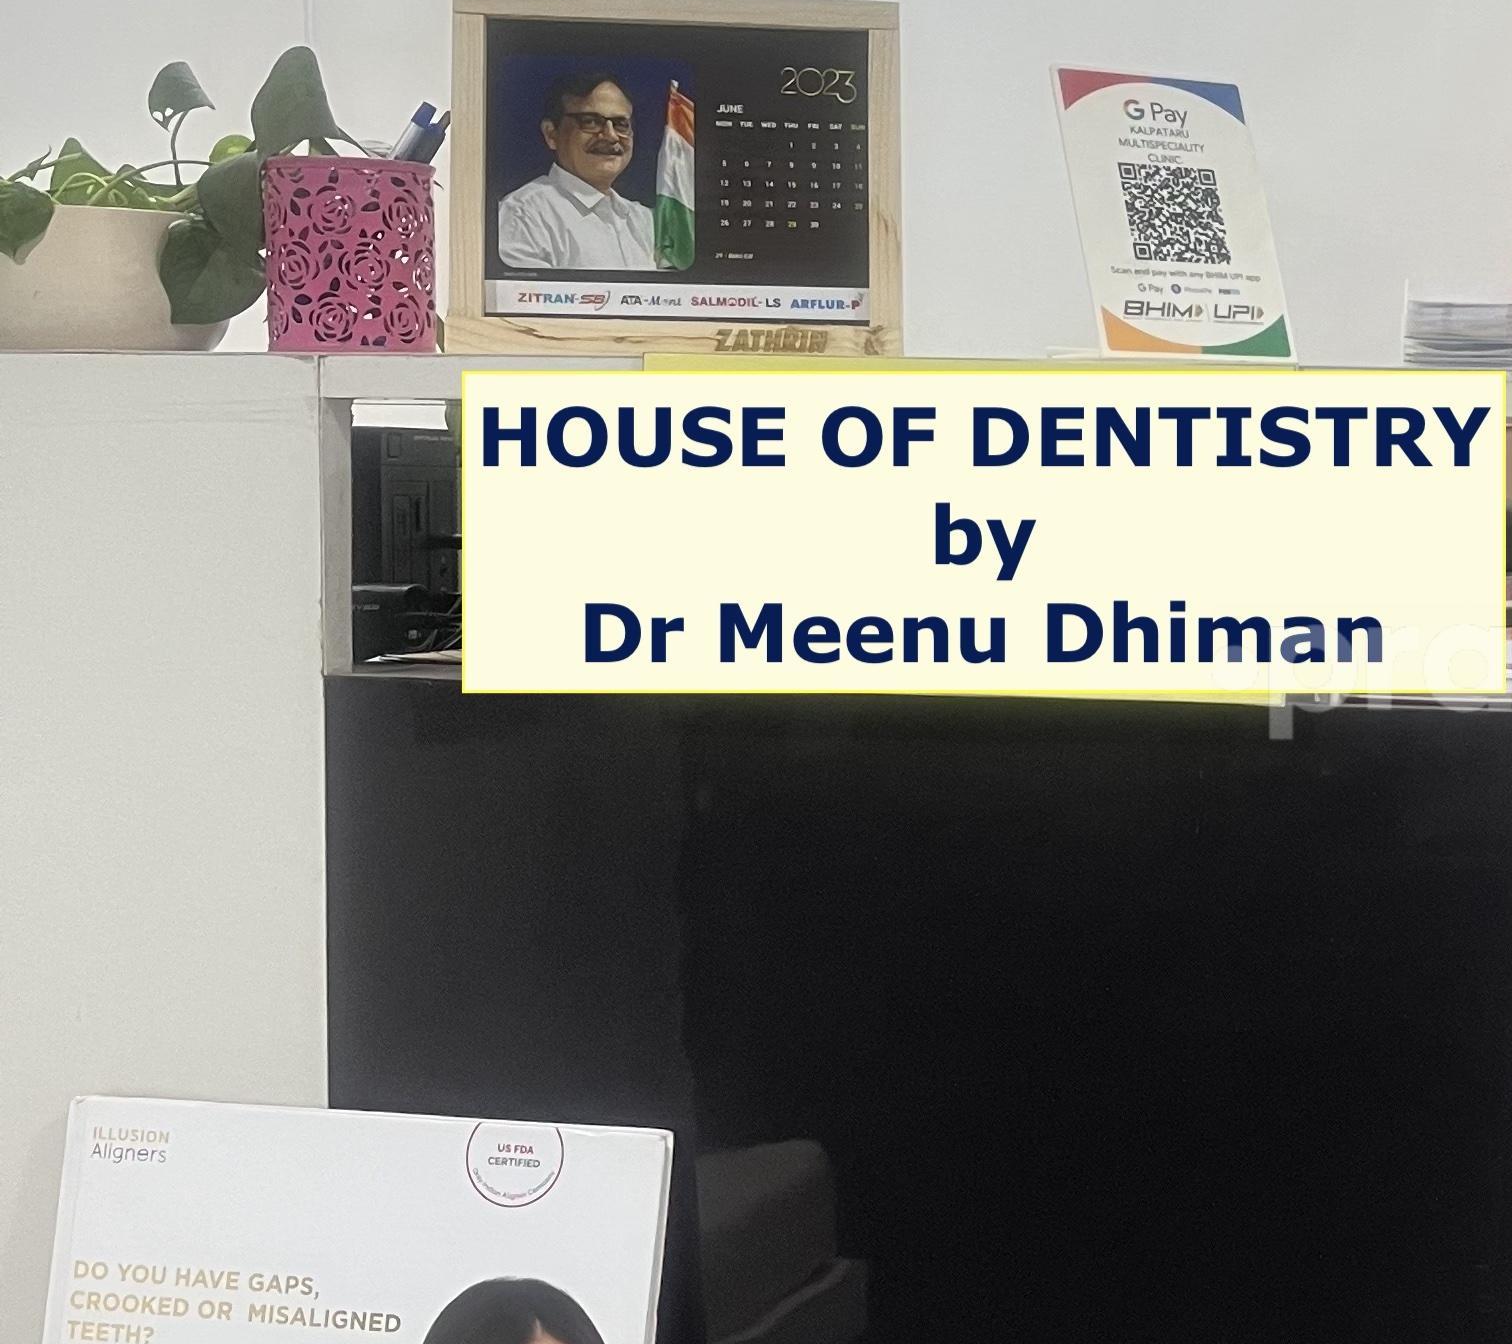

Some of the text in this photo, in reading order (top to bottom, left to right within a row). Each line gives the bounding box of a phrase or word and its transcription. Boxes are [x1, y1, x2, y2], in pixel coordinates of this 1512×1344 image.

[780, 66, 857, 103] 2023
[717, 105, 744, 114] JUNE
[1123, 99, 1188, 128] G Pay
[1129, 126, 1190, 139] KALPATARU
[1119, 137, 1205, 153] MULTISPECIALITY
[1148, 153, 1183, 164] CLINIC
[720, 219, 729, 227] 26
[1124, 300, 1255, 320] BHIM UPI
[92, 1126, 170, 1144] ILLUSION
[92, 1142, 167, 1164] Aligners
[497, 1143, 534, 1154] US FDA
[488, 1157, 541, 1168] CERTIFIED
[73, 1260, 320, 1301] DO YOU HAVE GAPS,
[69, 1291, 401, 1334] CROOKED OR MISALIGNED
